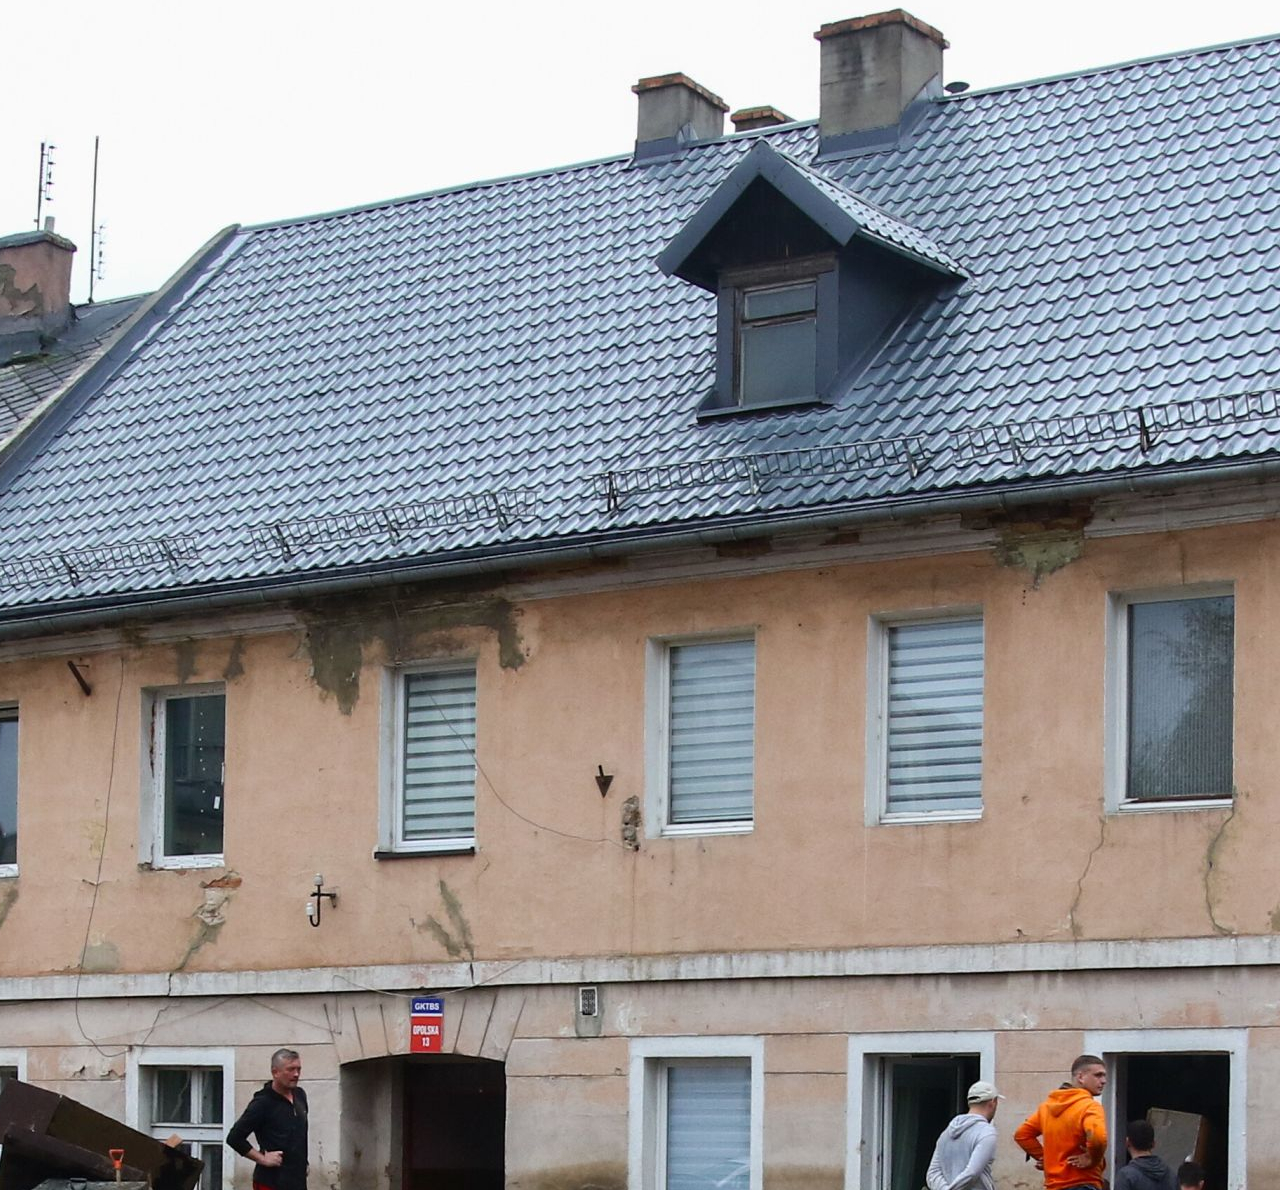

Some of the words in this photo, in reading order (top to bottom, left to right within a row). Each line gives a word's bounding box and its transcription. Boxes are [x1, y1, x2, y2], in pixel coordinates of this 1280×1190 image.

[414, 1002, 440, 1010] GKTBS
[412, 1025, 440, 1035] OPOLSKA
[422, 1037, 430, 1047] 13
